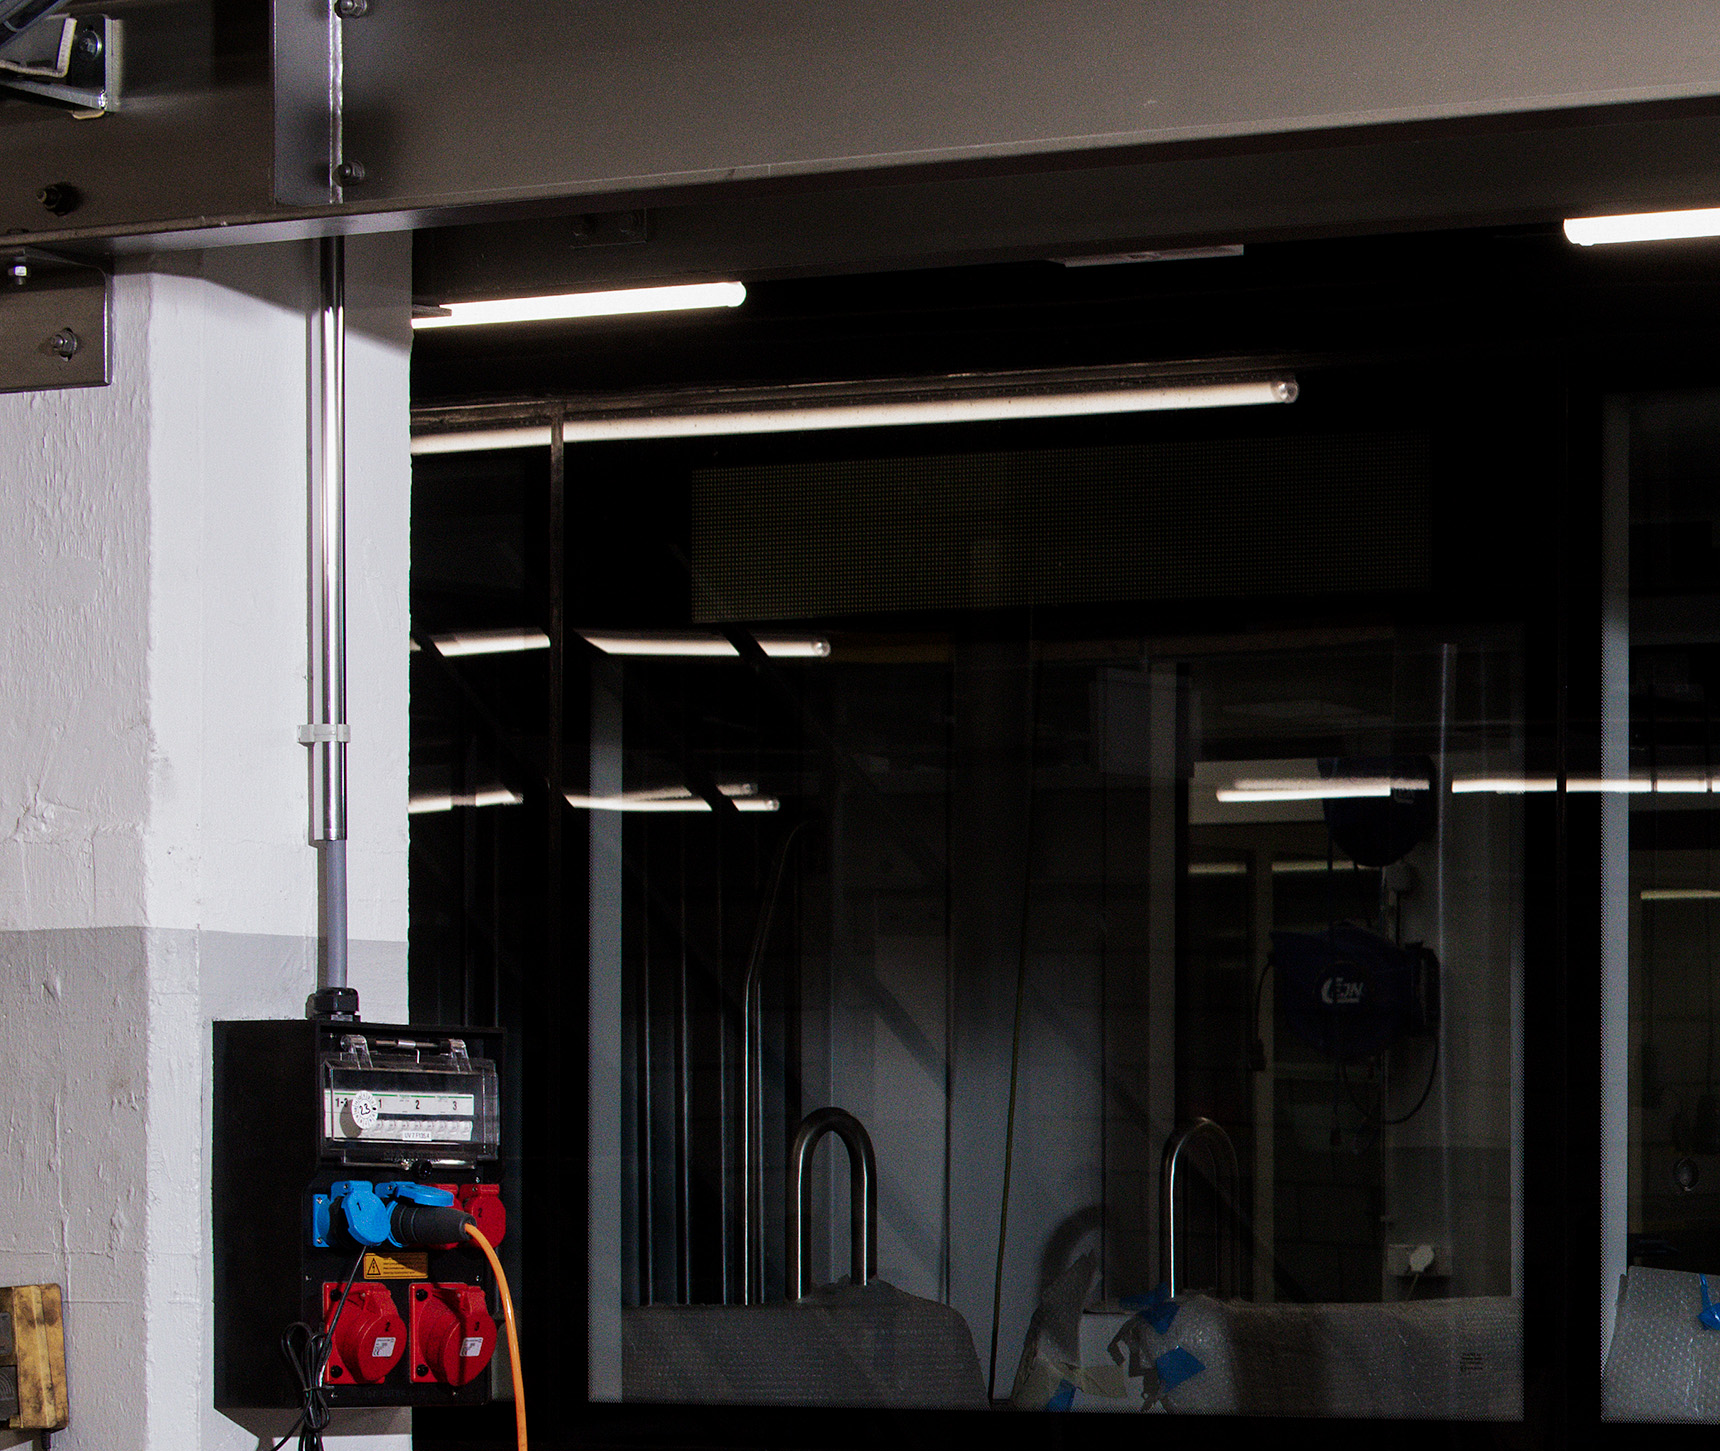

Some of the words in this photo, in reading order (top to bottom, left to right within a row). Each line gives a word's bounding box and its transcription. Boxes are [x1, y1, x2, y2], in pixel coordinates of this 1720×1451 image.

[359, 1102, 372, 1116] 23
[415, 1099, 421, 1110] 2
[452, 1100, 459, 1111] 3
